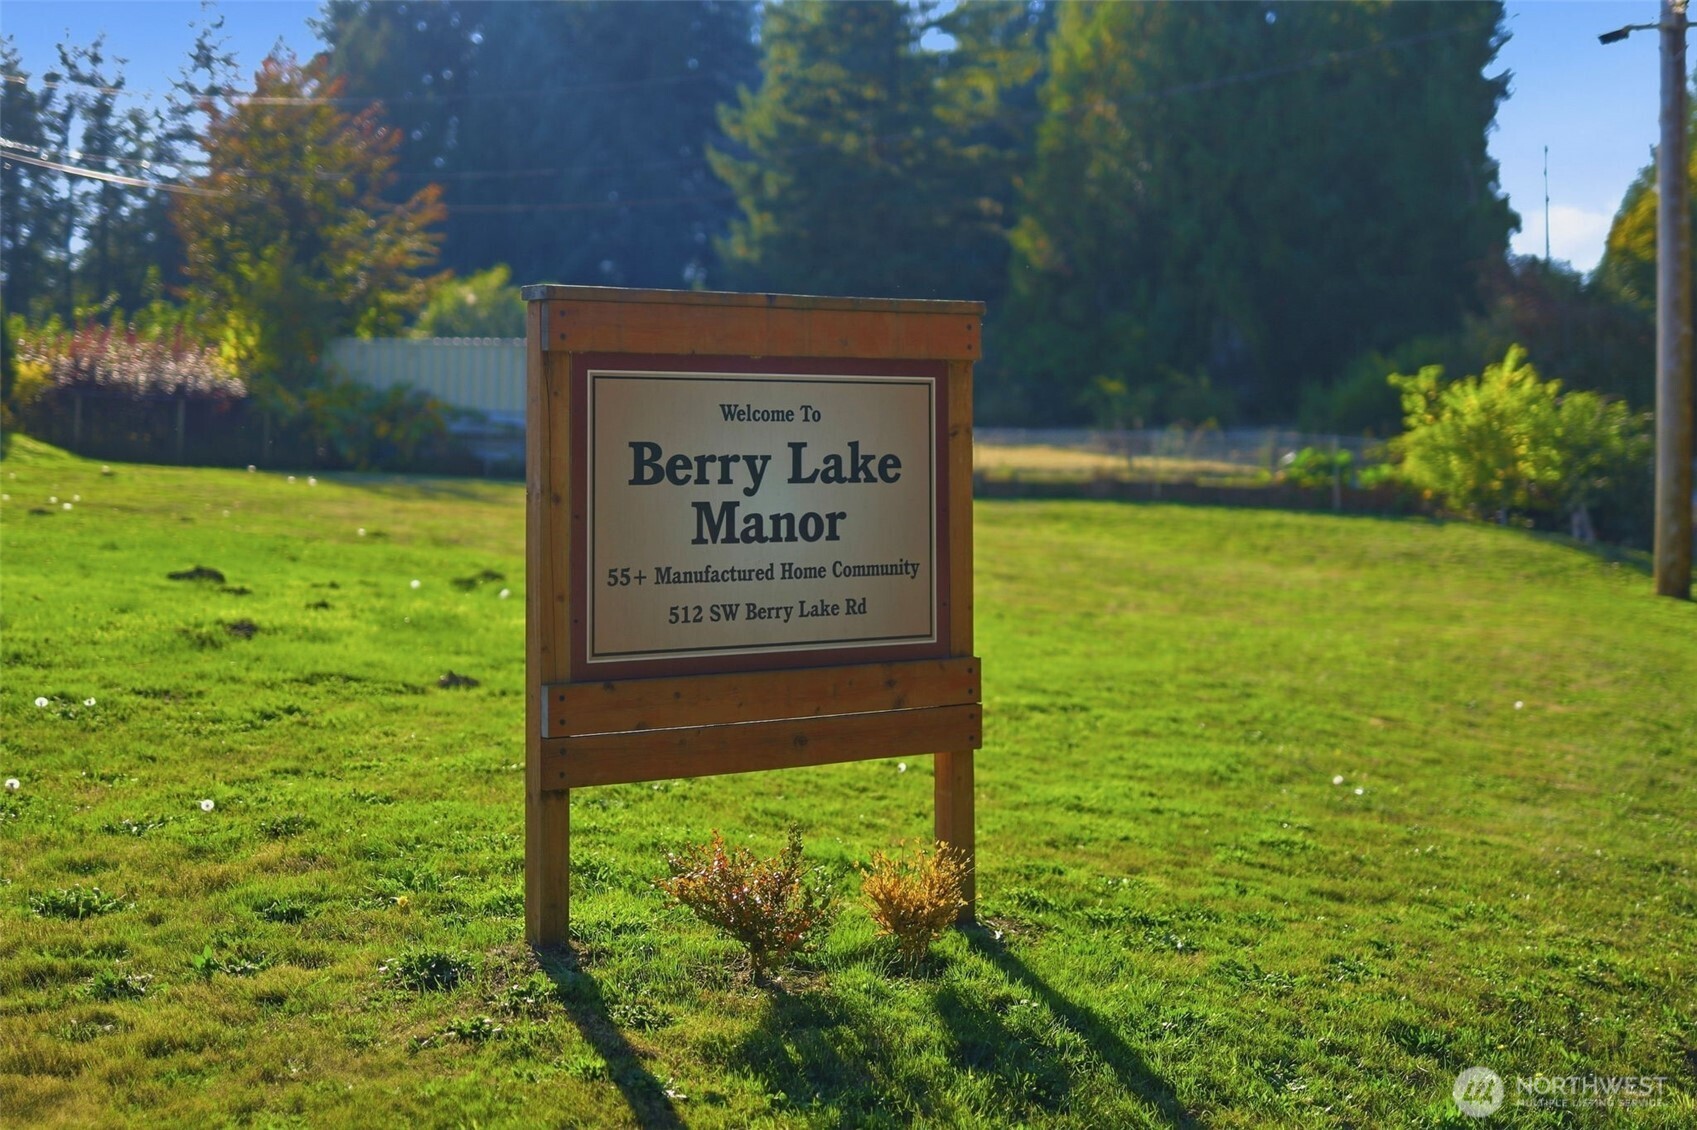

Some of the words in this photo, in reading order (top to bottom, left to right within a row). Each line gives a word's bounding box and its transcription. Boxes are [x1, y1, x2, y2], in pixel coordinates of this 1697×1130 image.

[720, 404, 794, 422] Welcome
[800, 405, 821, 422] To
[628, 441, 772, 496] Berry
[787, 440, 902, 484] Lake
[691, 501, 847, 545] Manor
[607, 568, 647, 586] 55+
[654, 563, 775, 585] Manufactured
[780, 562, 826, 580] Home
[832, 558, 920, 579] Community
[669, 606, 703, 624] 512
[710, 604, 740, 621] SW
[745, 602, 793, 622] Berry
[799, 599, 839, 617] Lake
[845, 598, 867, 615] Rd
